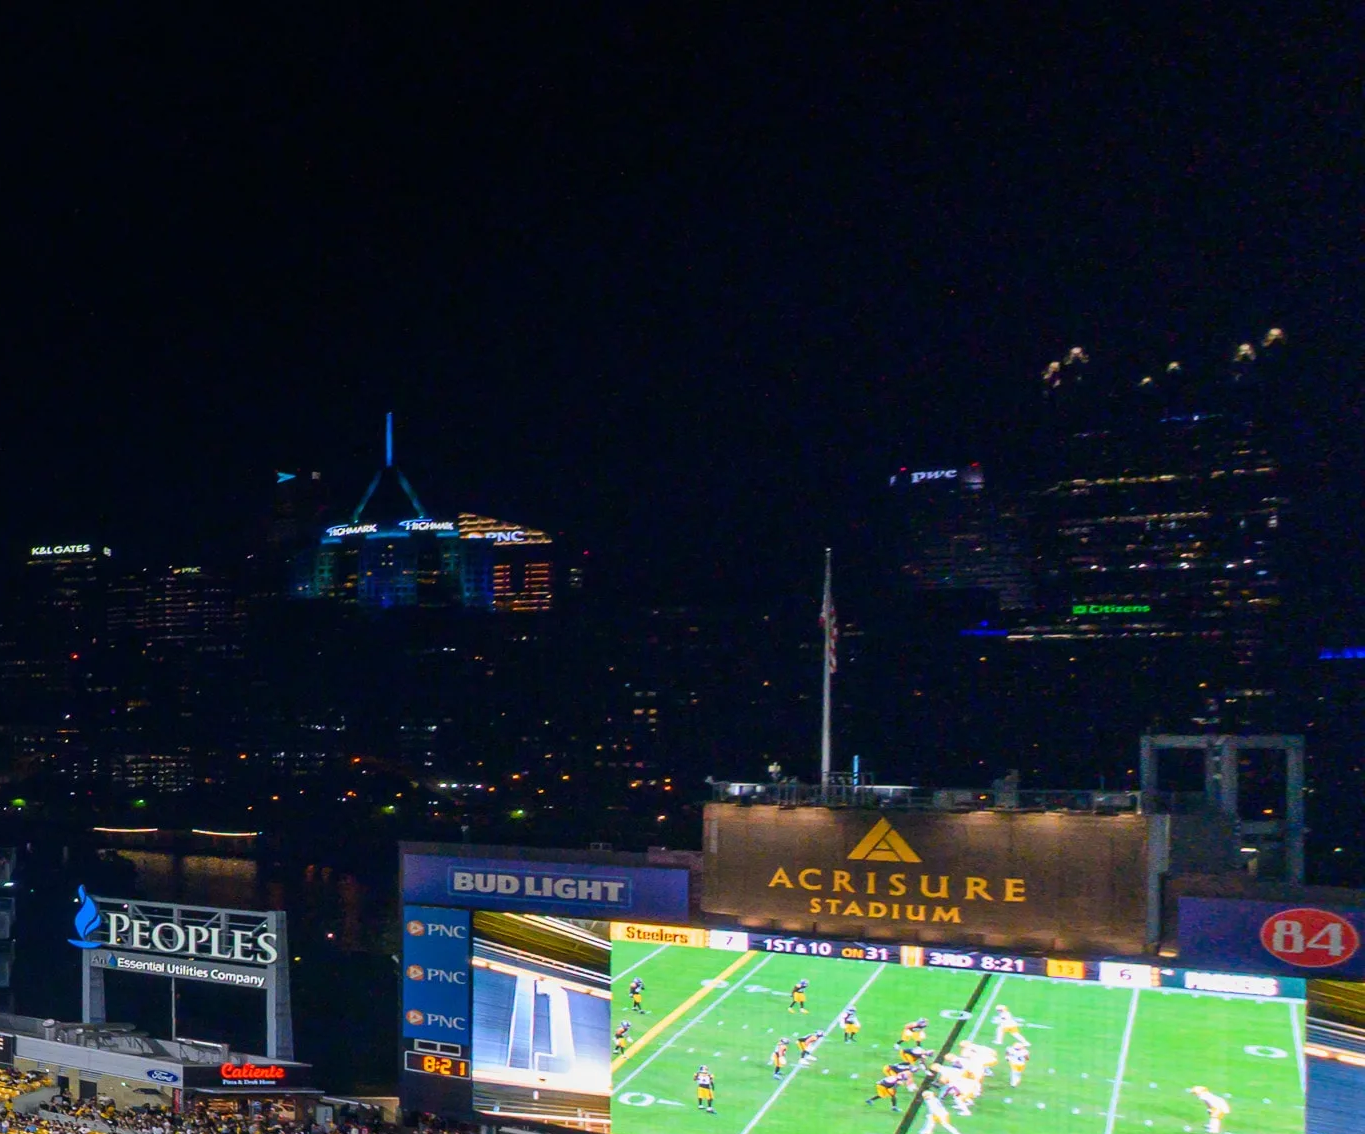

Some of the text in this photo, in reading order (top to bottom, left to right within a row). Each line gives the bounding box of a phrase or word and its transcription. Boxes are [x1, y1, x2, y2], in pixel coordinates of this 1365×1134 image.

[910, 467, 959, 484] pwc
[54, 544, 90, 554] GATES
[1088, 604, 1151, 616] Citizens
[453, 871, 625, 903] BUD LIGHT
[768, 867, 1026, 903] ACRISURE
[809, 897, 962, 924] STADIUM
[106, 912, 278, 964] PEOPLES
[427, 922, 466, 939] PNC
[626, 924, 689, 945] Steelers
[1272, 919, 1347, 957] 84
[725, 935, 734, 948] 7
[763, 937, 889, 960] 1ST & 10 ON 31
[91, 954, 265, 987] An Essential Utilities Company
[929, 951, 1025, 973] 3RD 8:21
[427, 968, 466, 985] PNC
[1119, 969, 1131, 983] 6
[427, 1014, 465, 1031] PNC
[151, 1070, 174, 1081] Ford
[220, 1062, 285, 1079] Caliente
[422, 1058, 466, 1077] 8:21
